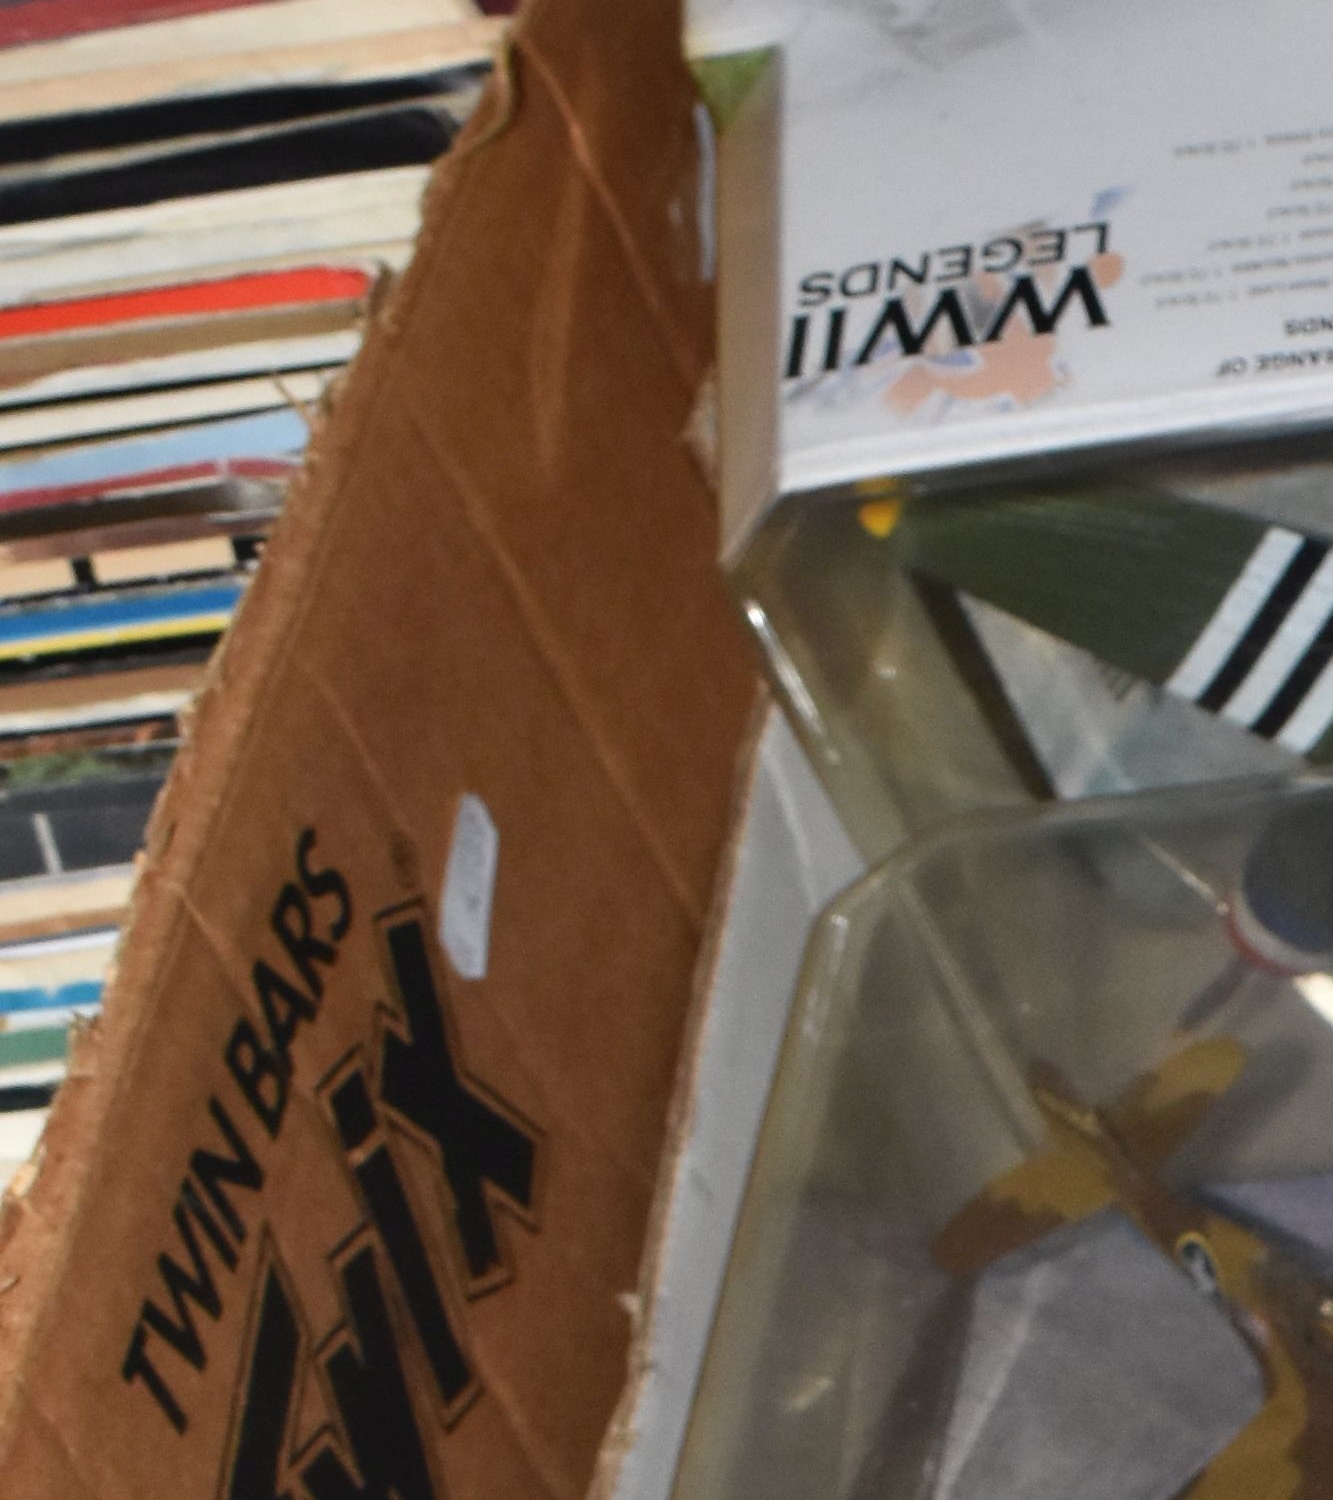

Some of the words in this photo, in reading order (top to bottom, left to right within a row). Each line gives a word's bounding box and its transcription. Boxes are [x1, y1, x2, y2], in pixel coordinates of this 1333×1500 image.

[799, 220, 1110, 307] LEGENDS
[785, 264, 1111, 379] WWII
[1214, 356, 1250, 379] OF
[120, 1094, 266, 1438] TWIN
[222, 828, 356, 1128] BARS
